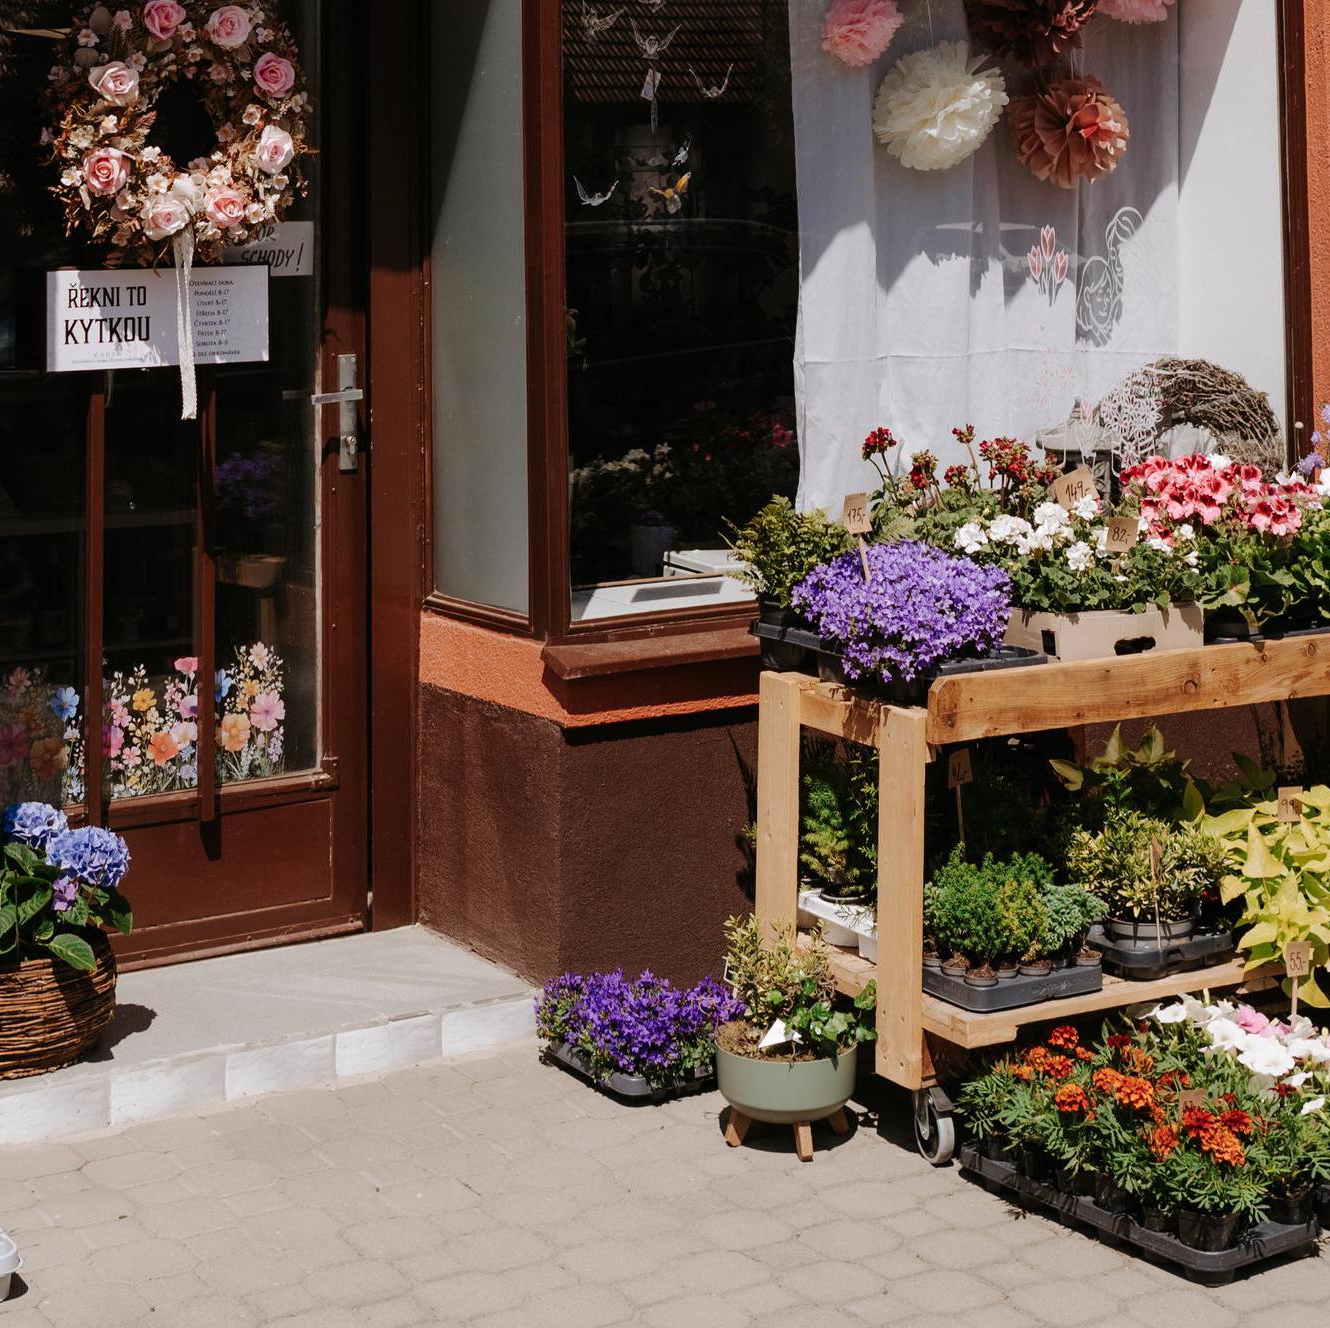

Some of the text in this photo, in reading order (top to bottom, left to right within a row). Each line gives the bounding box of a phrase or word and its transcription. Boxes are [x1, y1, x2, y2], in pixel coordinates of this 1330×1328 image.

[67, 282, 148, 309] ŘEKNI TO
[63, 315, 151, 345] KYTKOU
